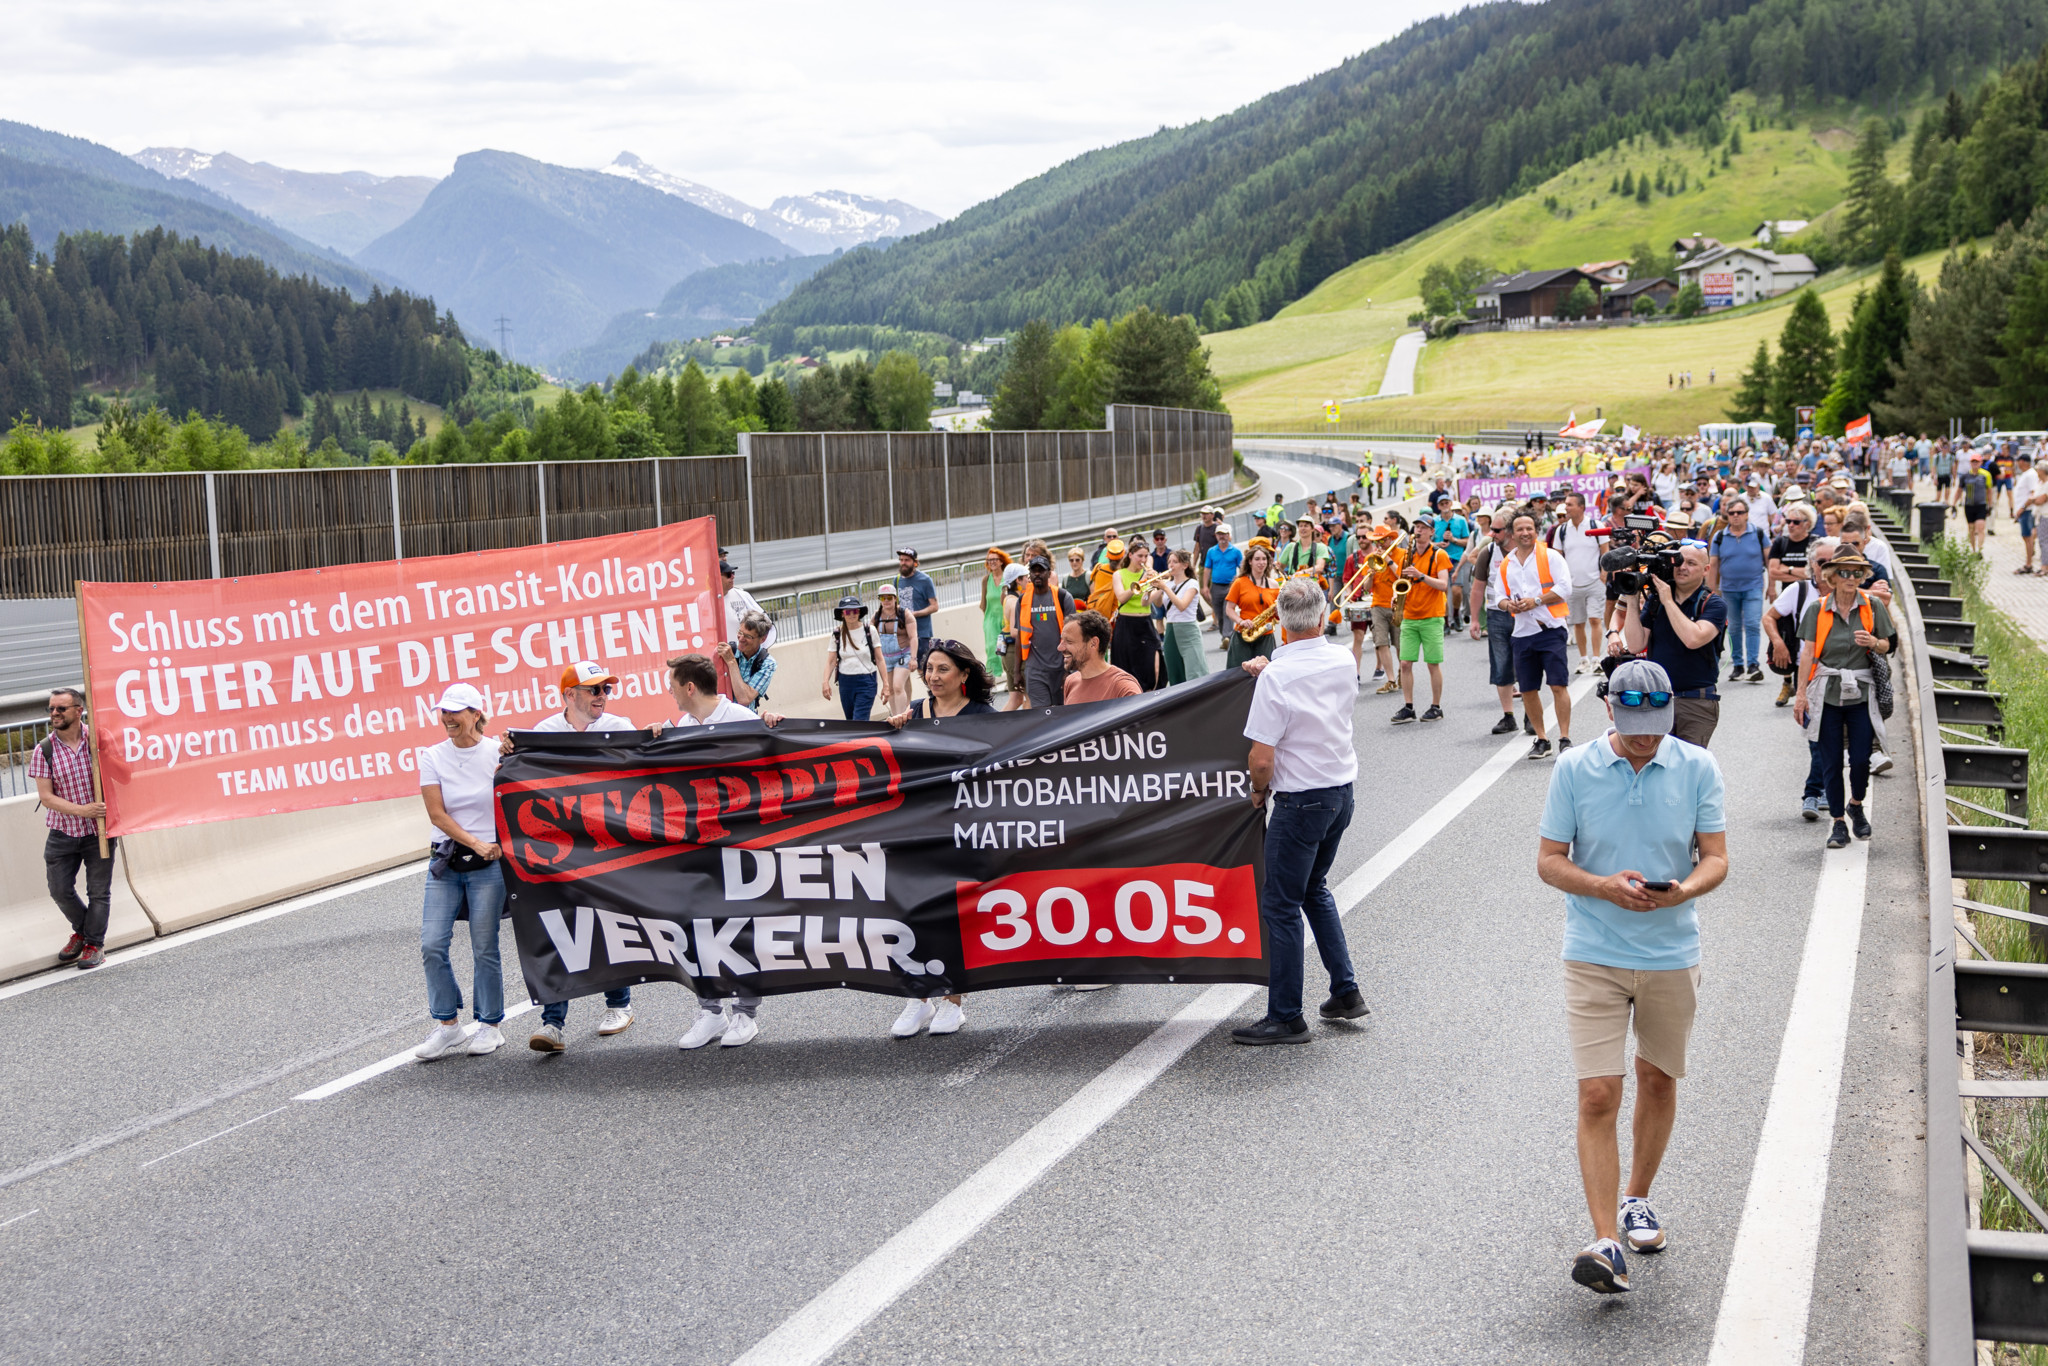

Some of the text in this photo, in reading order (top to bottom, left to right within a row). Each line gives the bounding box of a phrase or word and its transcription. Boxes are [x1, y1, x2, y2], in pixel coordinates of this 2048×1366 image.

[109, 547, 695, 653] Schluss mit dem Transit-Kollaps!
[115, 602, 703, 718] GÜTER AUF DIE SCHIENE!
[123, 724, 238, 768] Bayern
[249, 716, 334, 750] muss
[344, 703, 406, 738] den
[217, 765, 288, 796] TEAM
[293, 752, 394, 787] KUGLER
[953, 770, 1250, 809] AUTOBAHNABFAHR
[517, 757, 876, 867] STOPPT
[953, 819, 1066, 849] MATREI
[721, 842, 887, 901] DEN
[538, 906, 945, 977] VERKEHR.
[976, 879, 1246, 950] 30.05.
